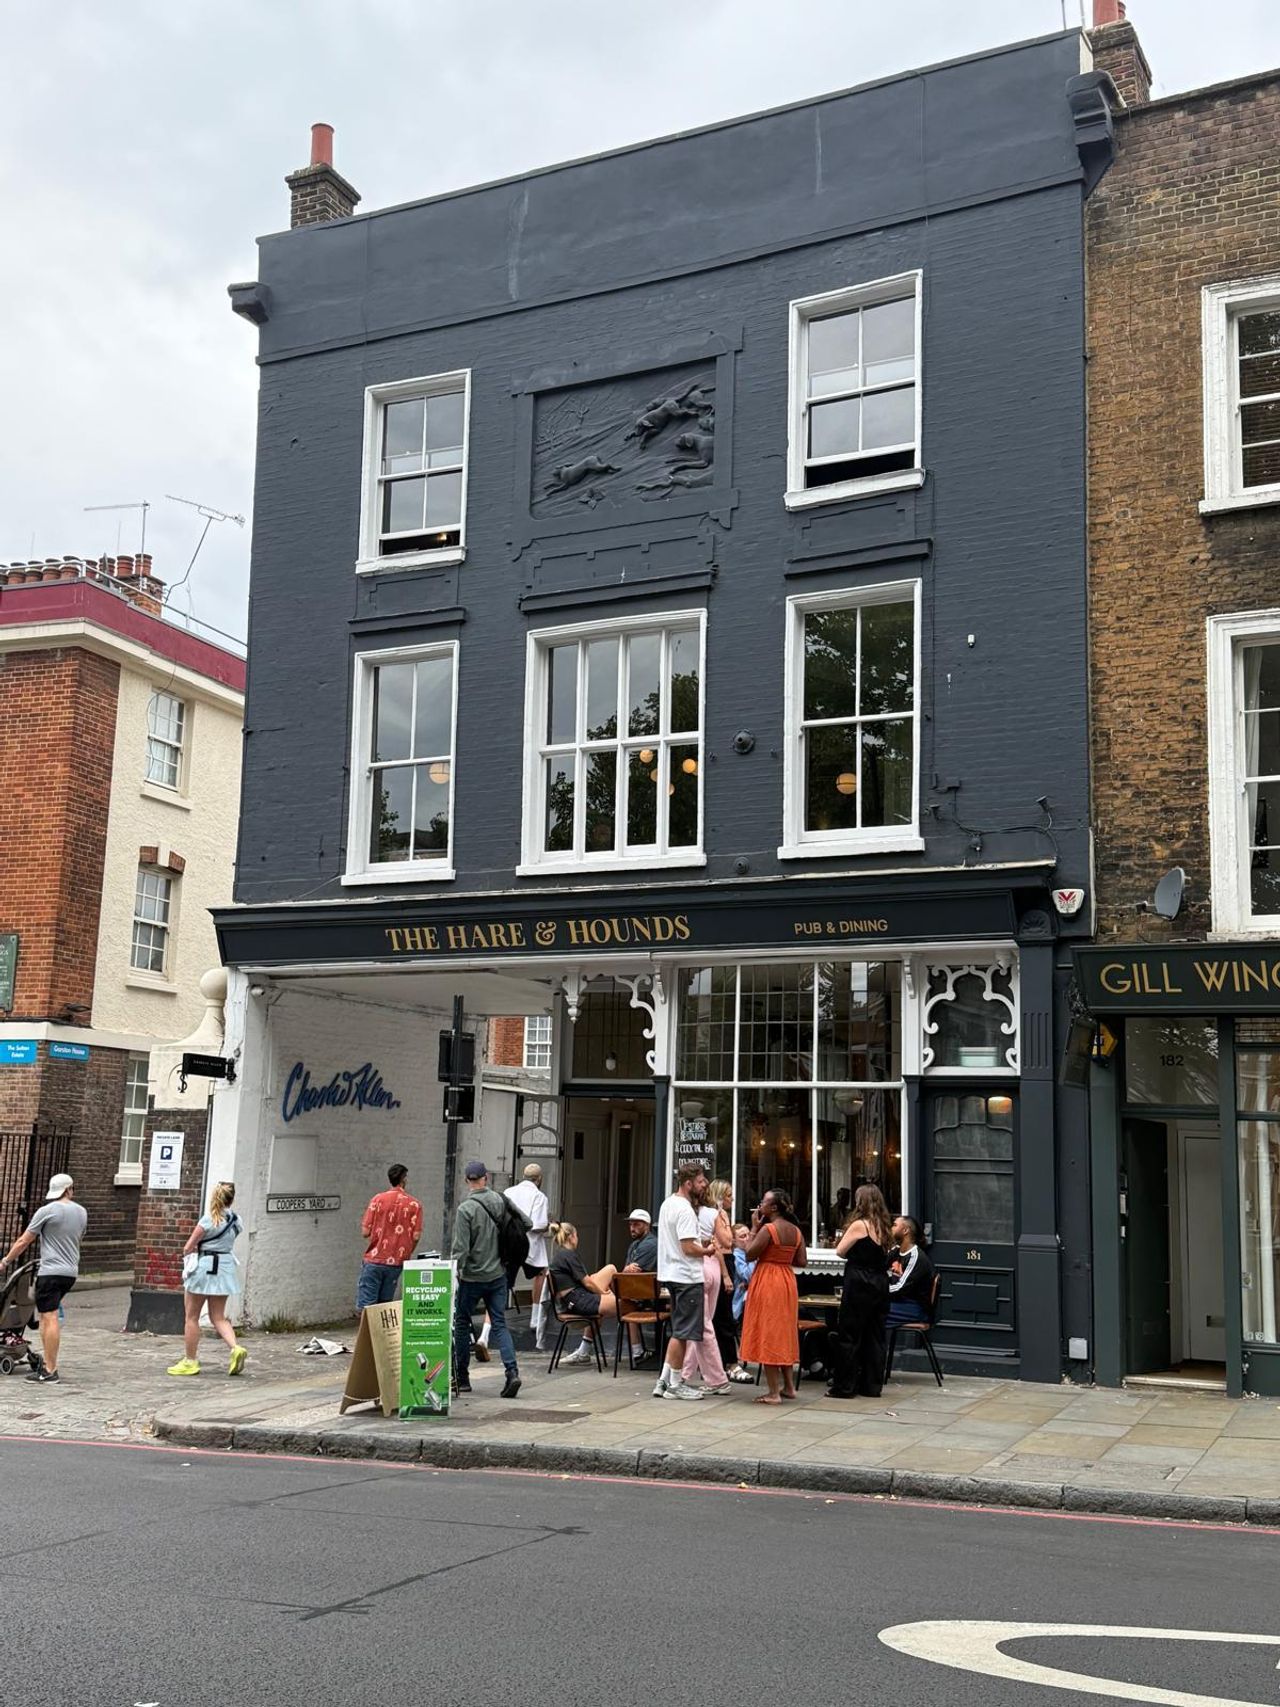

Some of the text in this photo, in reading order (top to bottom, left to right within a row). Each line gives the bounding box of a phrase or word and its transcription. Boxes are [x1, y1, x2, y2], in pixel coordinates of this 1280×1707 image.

[385, 915, 690, 951] THE HARE & HOUNDS
[794, 919, 888, 935] PUB & DINING
[1100, 959, 1280, 994] GILL WIN
[1160, 1054, 1184, 1067] 182
[276, 1200, 305, 1210] COOPERS
[309, 1198, 325, 1209] YARD
[967, 1250, 981, 1260] 181
